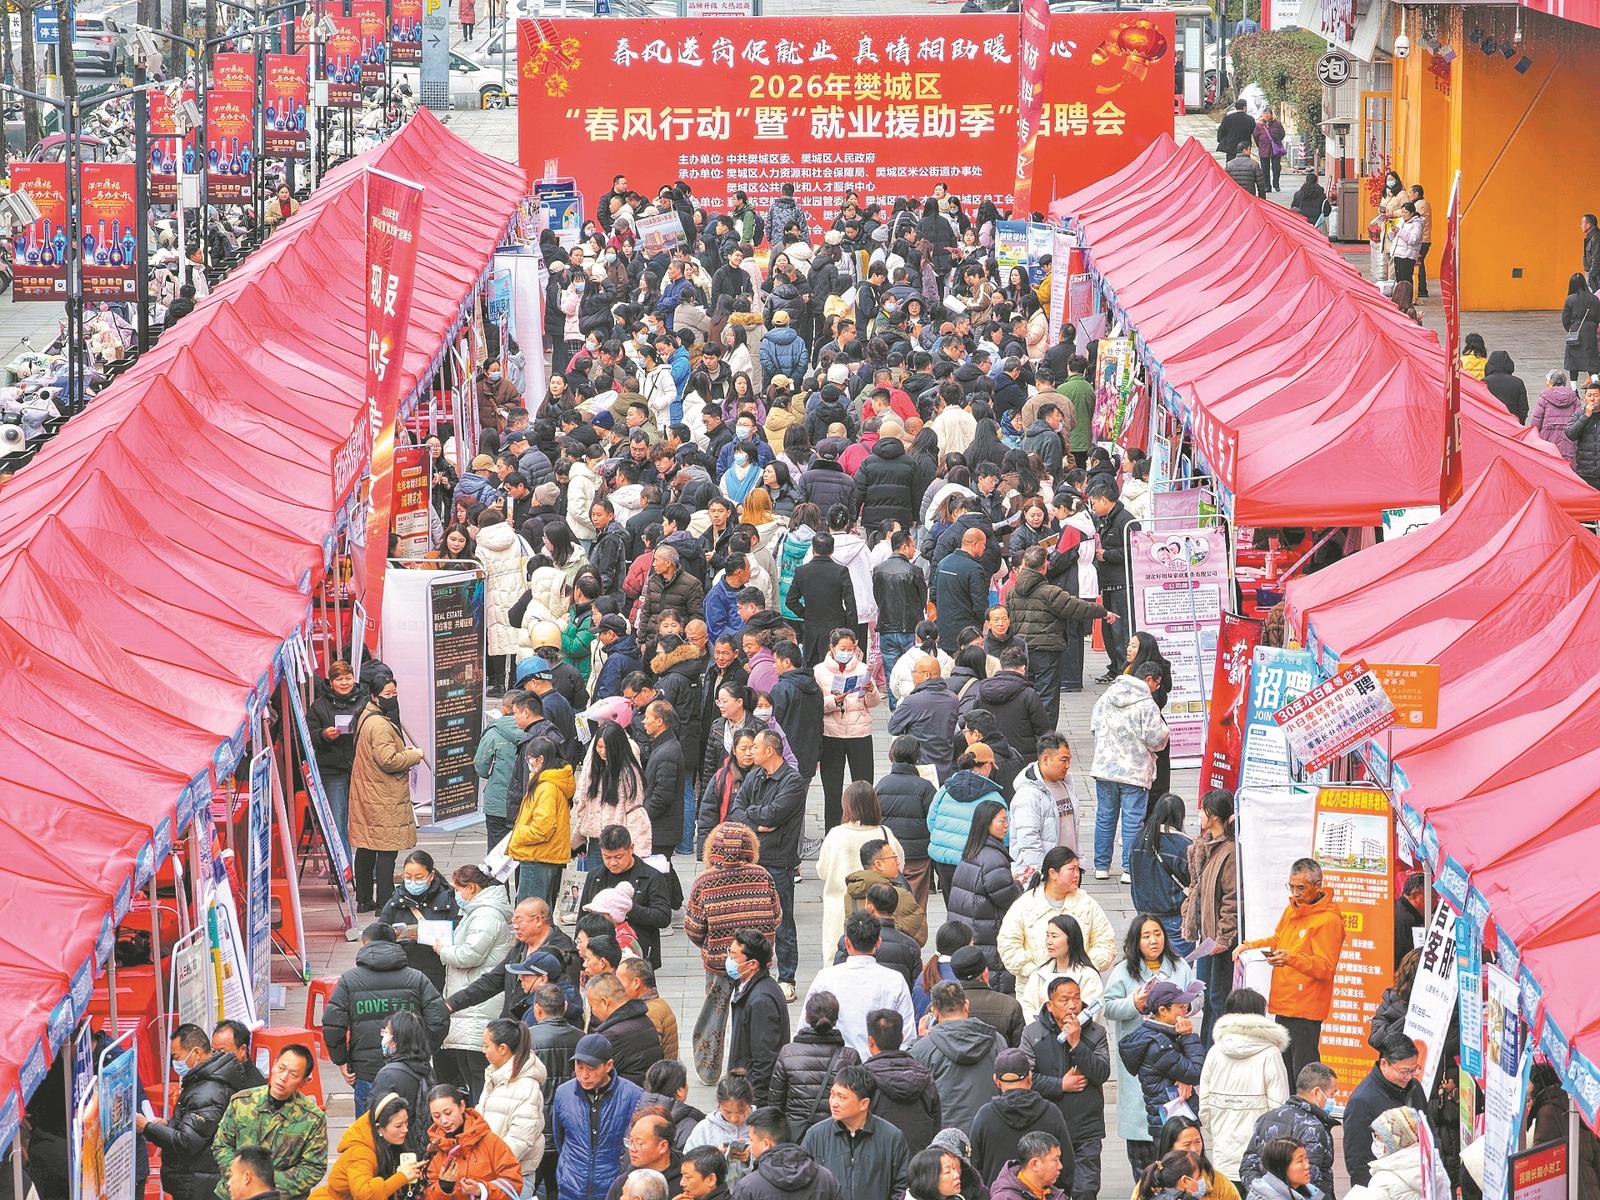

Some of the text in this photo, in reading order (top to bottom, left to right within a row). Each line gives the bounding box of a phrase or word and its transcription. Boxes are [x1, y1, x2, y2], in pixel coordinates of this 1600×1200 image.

[610, 33, 1078, 68] 春风送岗促就业 真情相助暖心
[1321, 57, 1347, 80] 泡
[749, 72, 942, 101] 2026年樊城区
[446, 609, 463, 619] ESTATE
[1354, 675, 1376, 696] 聘
[1254, 710, 1272, 722] JOIN
[356, 998, 389, 1015] COVE
